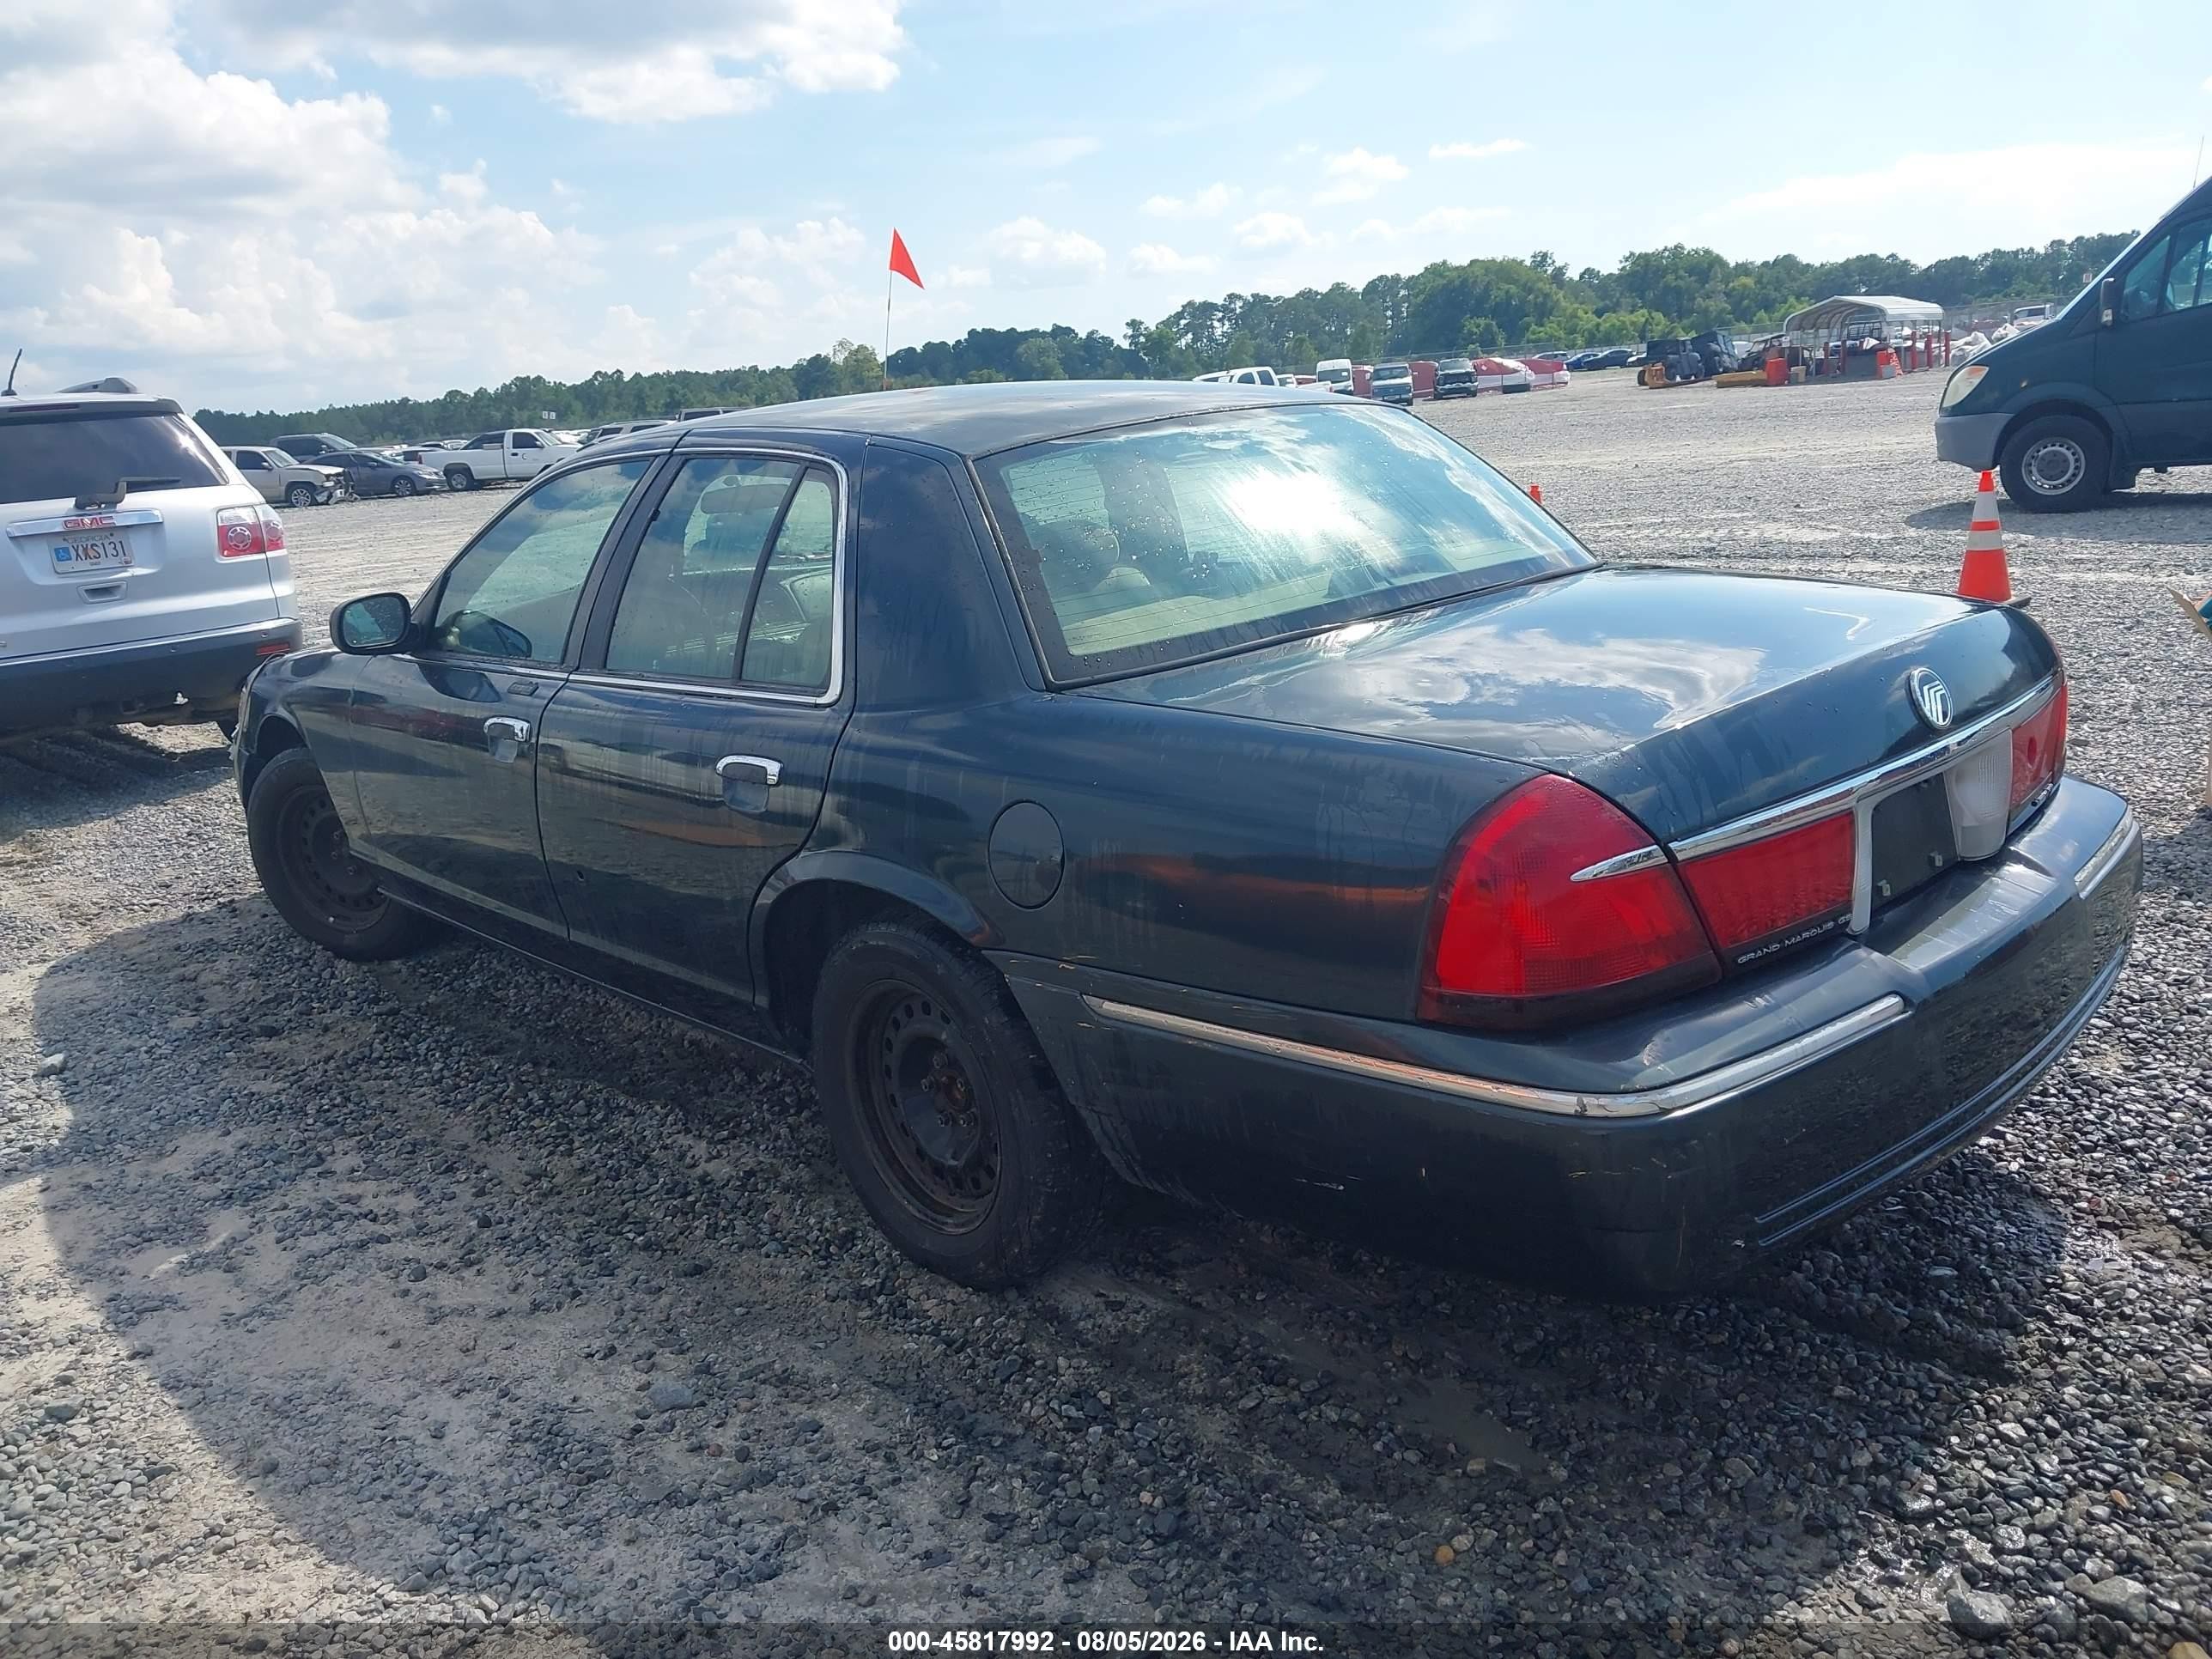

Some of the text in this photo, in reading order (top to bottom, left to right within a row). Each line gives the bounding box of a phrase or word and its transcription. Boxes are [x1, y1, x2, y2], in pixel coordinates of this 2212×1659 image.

[63, 516, 117, 530] GMC
[71, 540, 127, 562] XXS131
[1737, 943, 1780, 964] GRAND
[1784, 921, 1835, 947] MARQUIS
